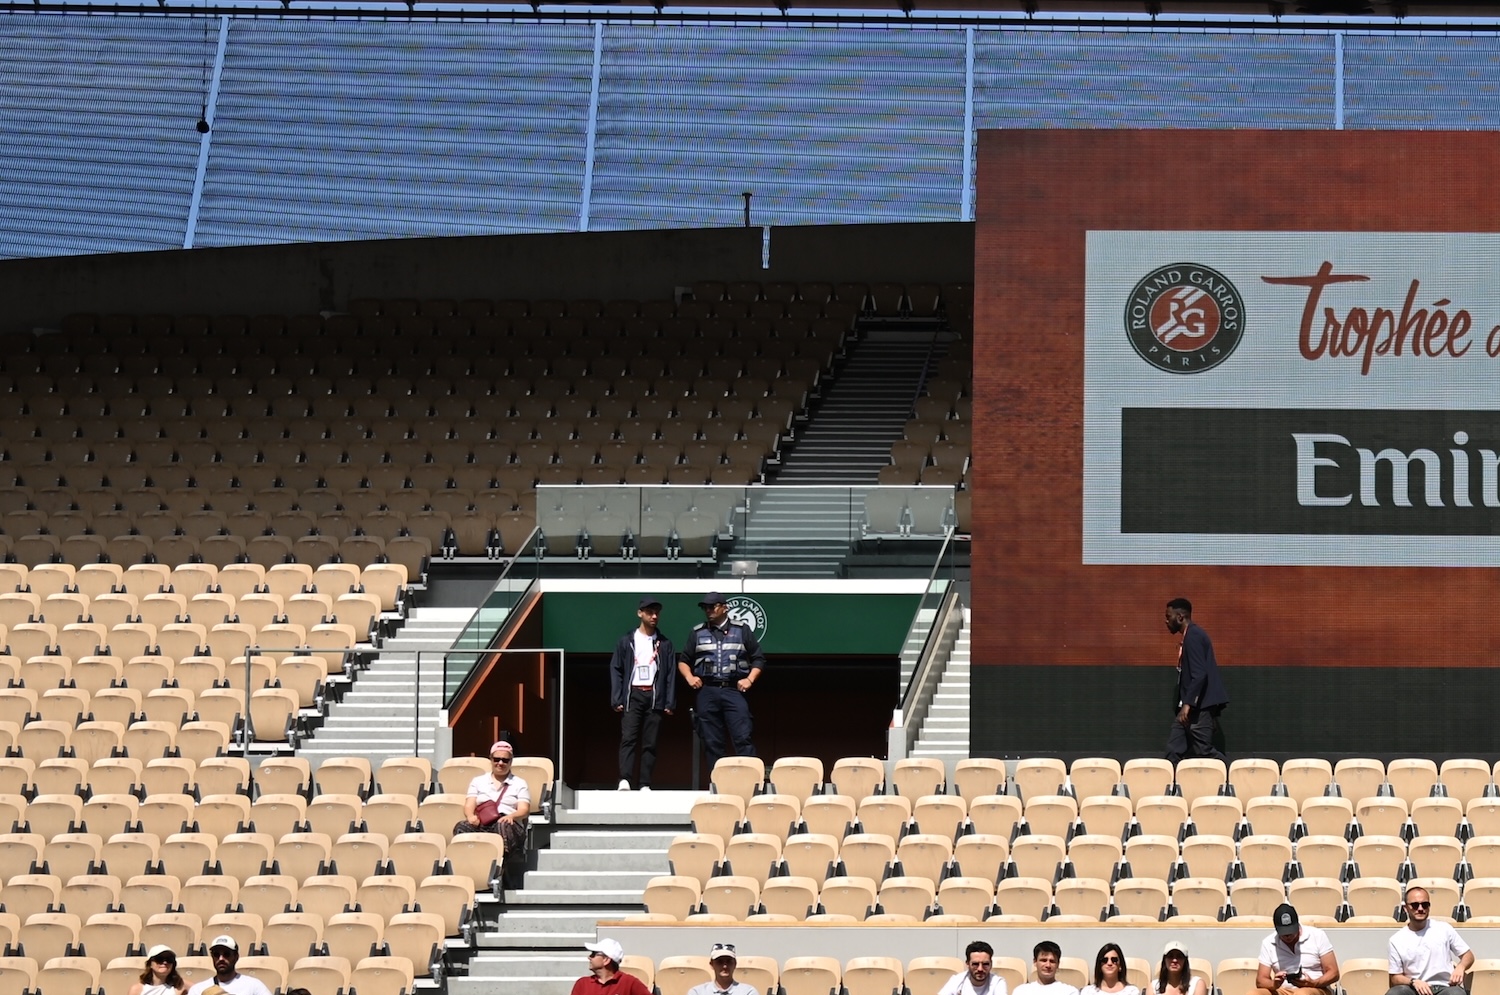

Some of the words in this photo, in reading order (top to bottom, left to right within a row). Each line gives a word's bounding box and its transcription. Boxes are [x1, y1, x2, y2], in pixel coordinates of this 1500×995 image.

[1132, 270, 1182, 330] ROLAND
[1189, 271, 1238, 331] GARROS
[1149, 346, 1221, 366] PARIS
[741, 599, 765, 630] GARROS
